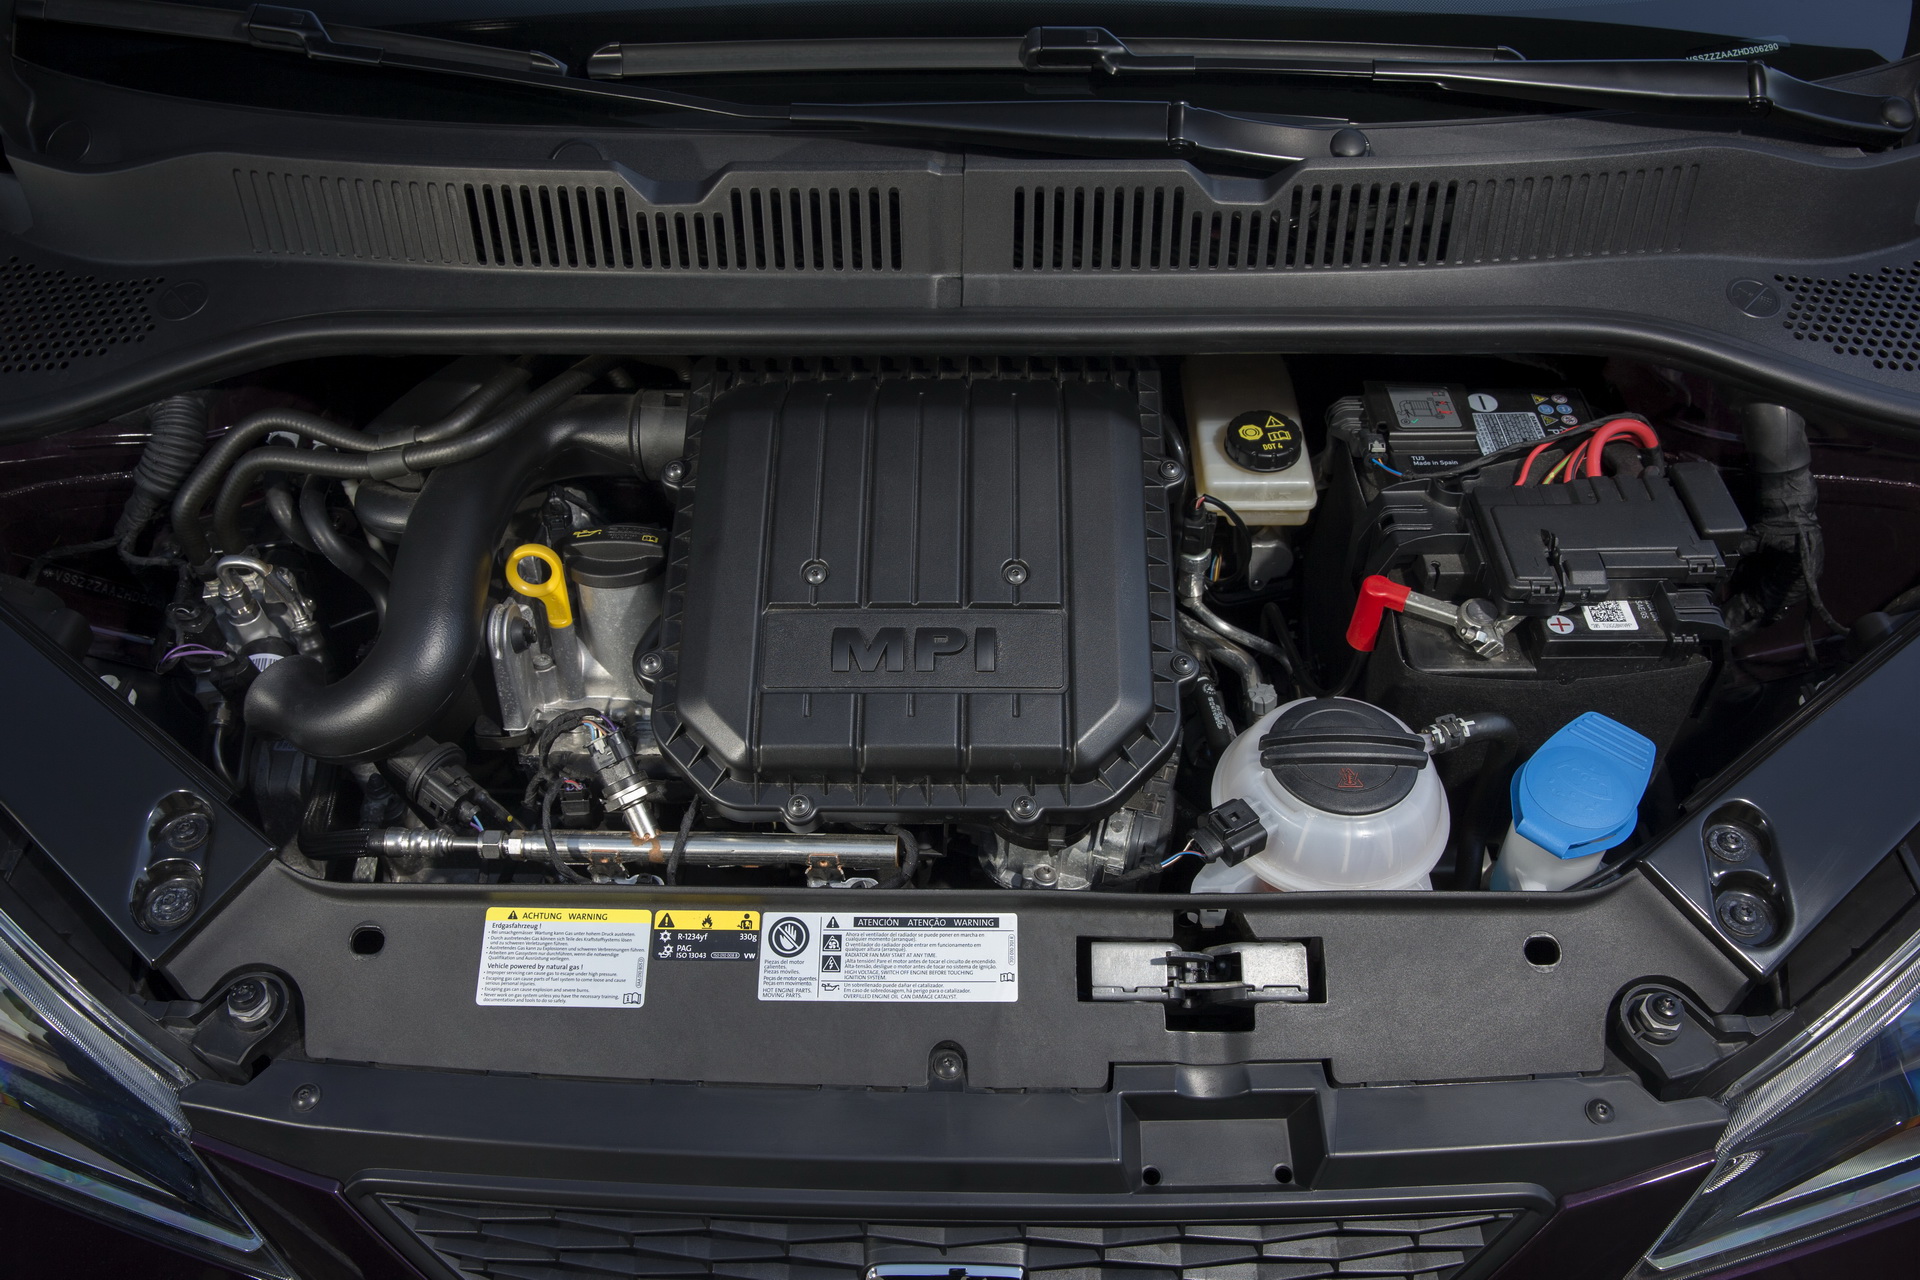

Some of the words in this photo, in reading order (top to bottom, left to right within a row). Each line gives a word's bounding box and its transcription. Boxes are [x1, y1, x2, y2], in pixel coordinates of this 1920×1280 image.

[831, 627, 996, 672] MPI
[857, 917, 898, 926] ATENCIÓN
[907, 917, 946, 927] ATENÇÃO
[678, 933, 708, 942] R-1234yf
[740, 933, 757, 942] 330g
